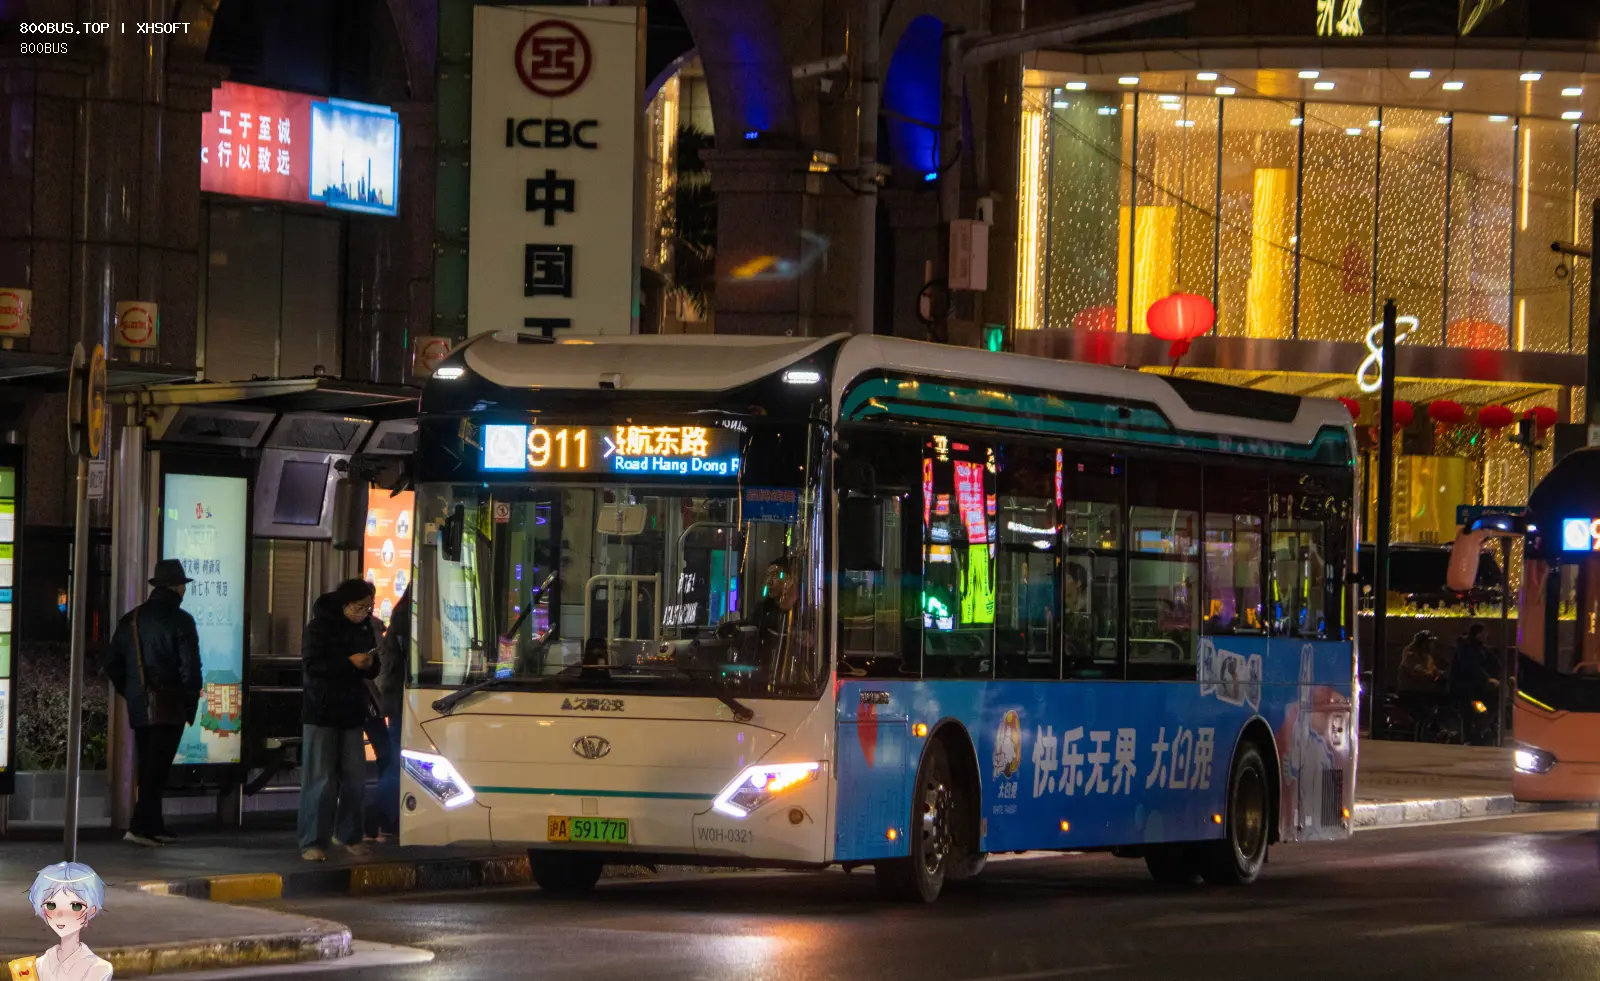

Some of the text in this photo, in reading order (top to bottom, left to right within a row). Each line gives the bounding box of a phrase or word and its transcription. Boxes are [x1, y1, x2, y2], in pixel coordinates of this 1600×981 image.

[219, 110, 291, 145] 工于至诚
[505, 117, 599, 149] ICBC
[218, 141, 291, 175] 行以致远
[526, 428, 588, 468] 911
[616, 456, 648, 470] Road
[653, 457, 688, 473] Hang
[692, 457, 727, 474] Dong
[1032, 724, 1216, 799] 快乐无界 大白兔
[998, 782, 1018, 799] 大白兔
[549, 819, 627, 840] 沪A 59177D
